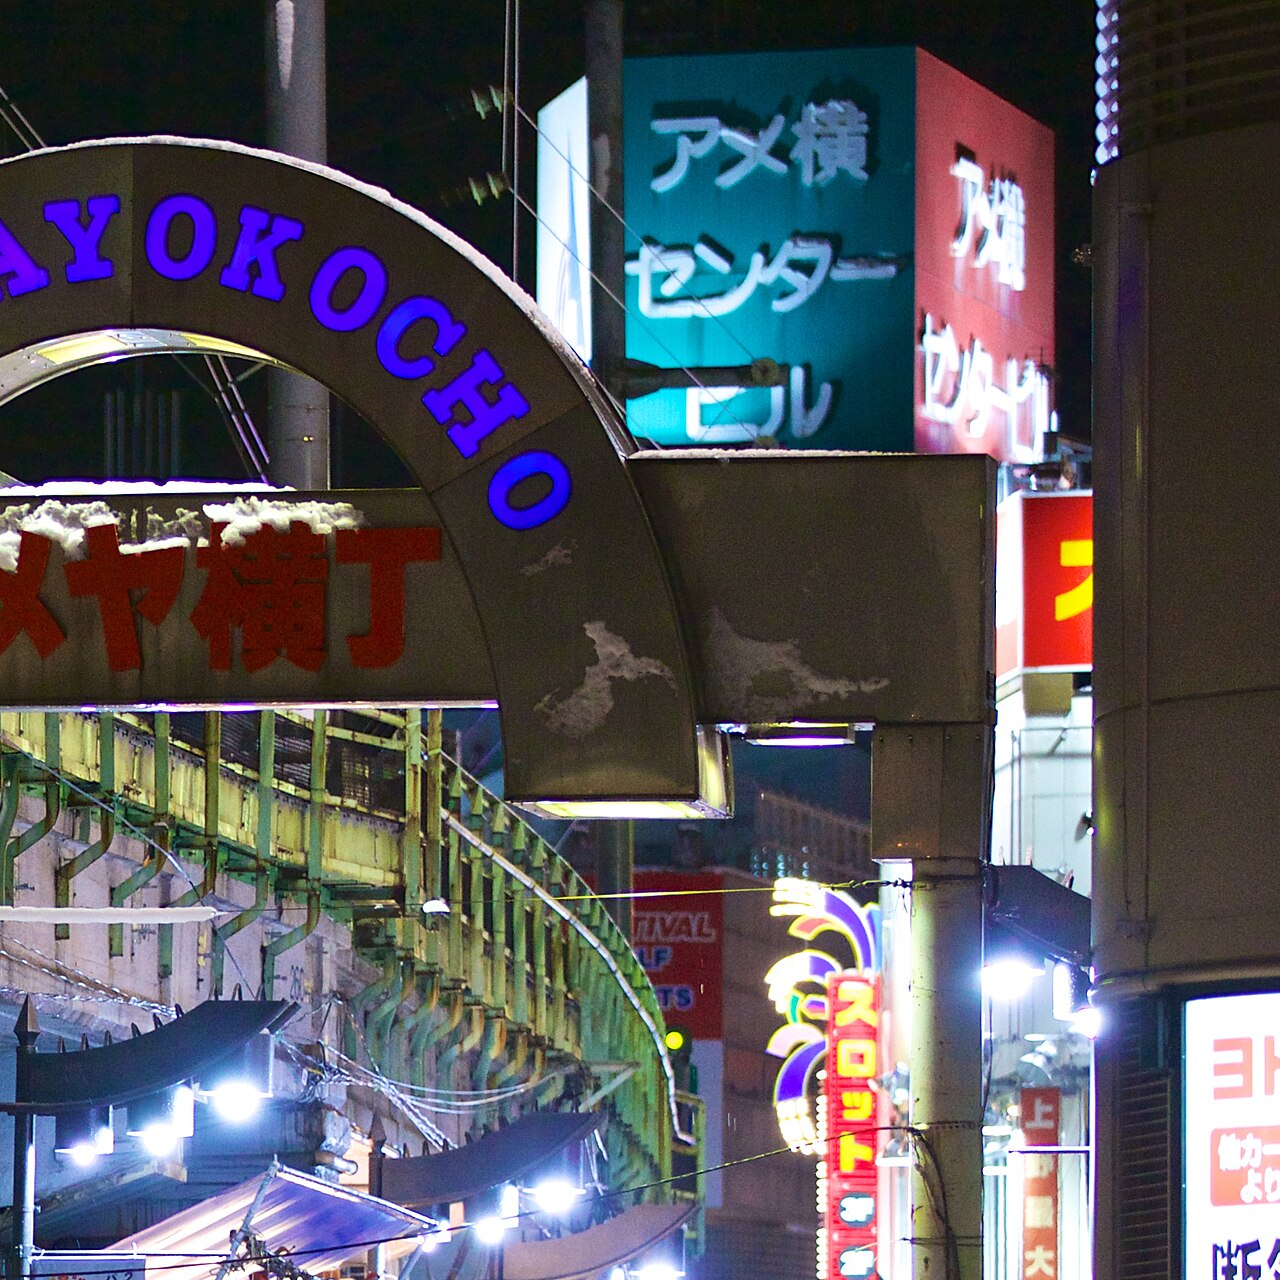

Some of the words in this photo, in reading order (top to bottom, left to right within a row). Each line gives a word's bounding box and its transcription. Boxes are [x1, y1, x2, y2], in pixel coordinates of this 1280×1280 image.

[651, 100, 870, 193] アメ横
[625, 235, 899, 318] センター
[836, 980, 877, 1174] スロット
